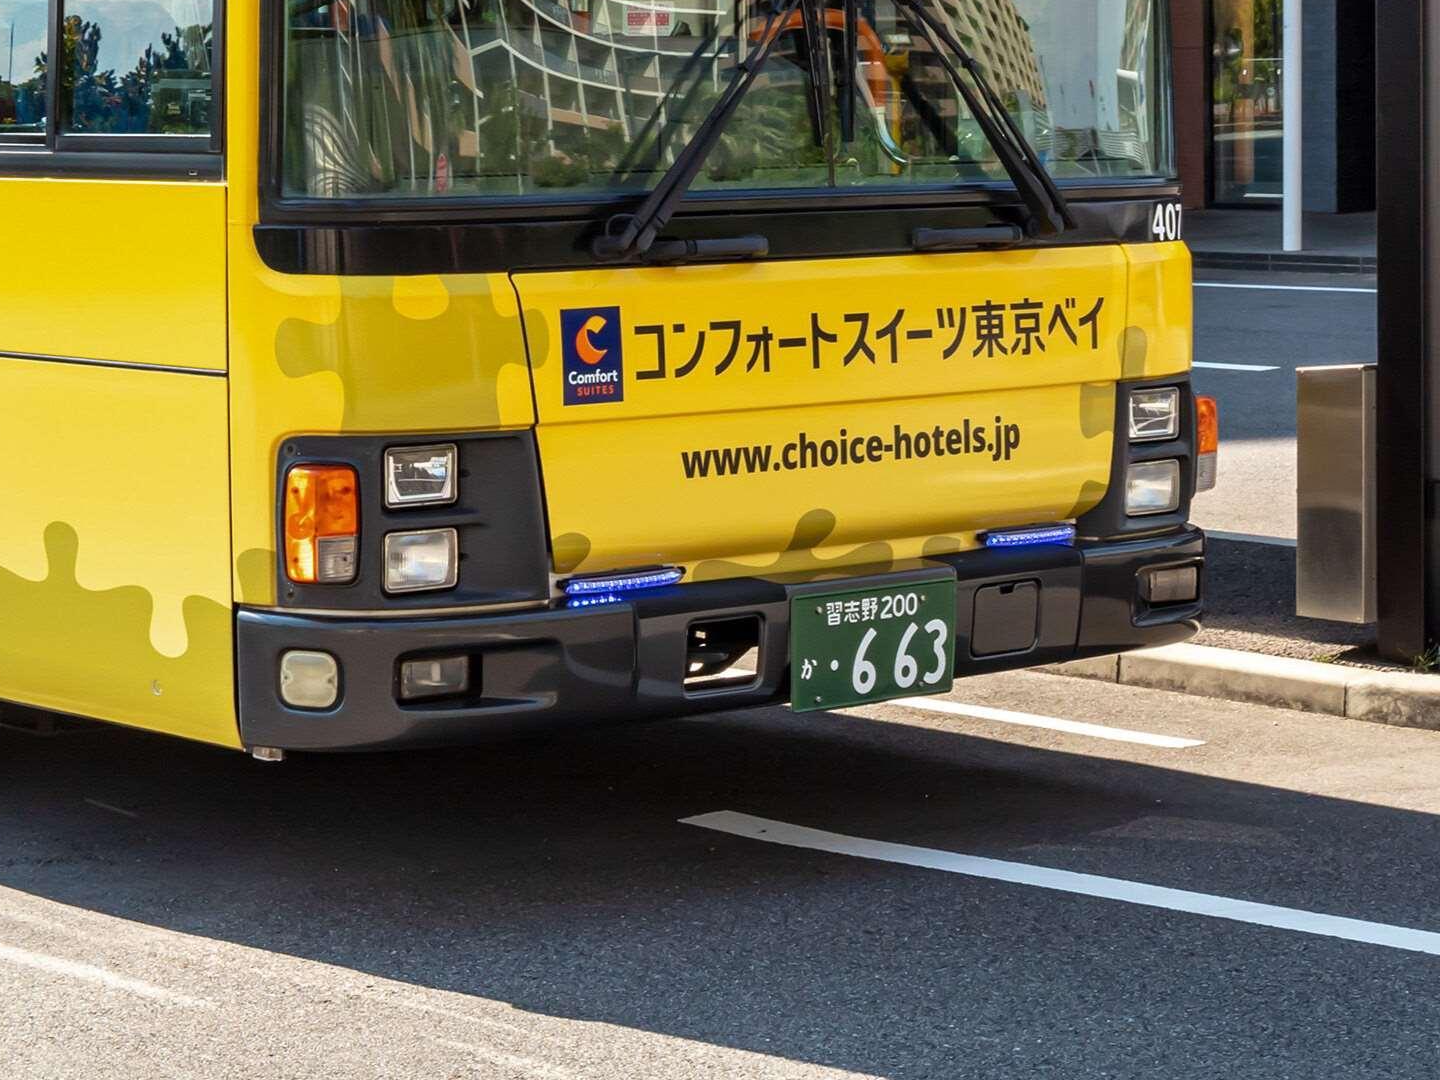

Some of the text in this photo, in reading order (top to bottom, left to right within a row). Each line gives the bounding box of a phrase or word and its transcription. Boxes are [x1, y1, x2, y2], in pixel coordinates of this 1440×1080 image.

[634, 297, 1104, 381] コンフォートスイーツ東京ベイ
[568, 368, 619, 386] Comfort
[576, 384, 615, 398] SUITES
[681, 415, 1020, 479] www.choice-hotels.jp
